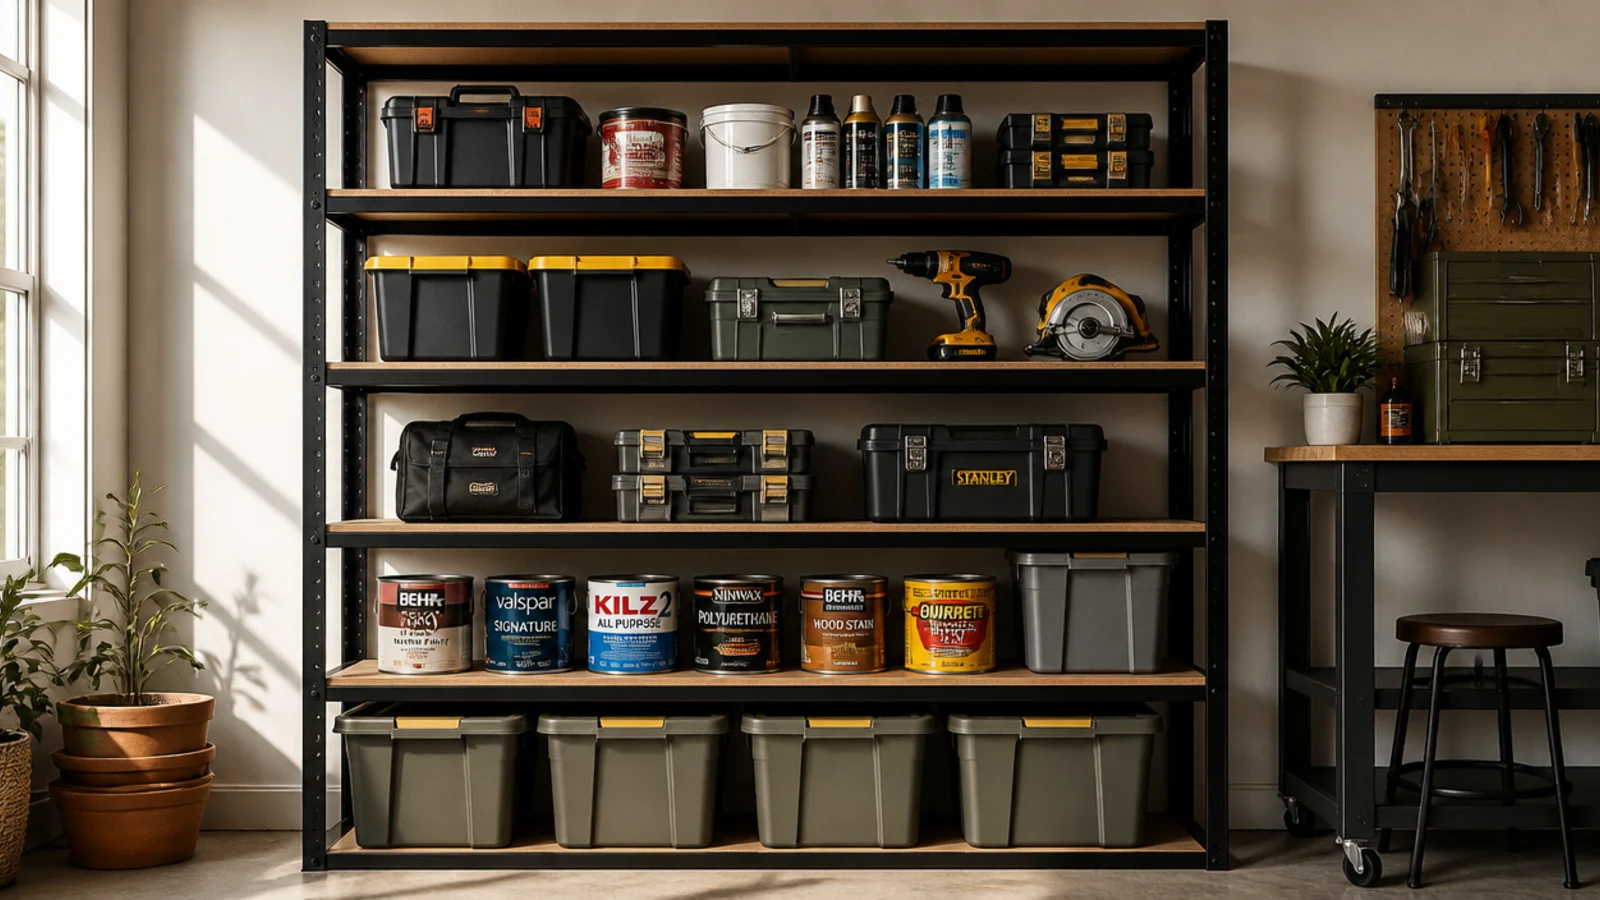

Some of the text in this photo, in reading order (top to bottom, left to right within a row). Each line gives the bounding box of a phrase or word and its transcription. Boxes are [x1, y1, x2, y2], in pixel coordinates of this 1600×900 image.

[956, 470, 1013, 485] STANLEY
[495, 592, 556, 616] valspar
[494, 620, 557, 633] SIGNATURE
[597, 618, 614, 629] ALL
[845, 618, 874, 631] STAIN
